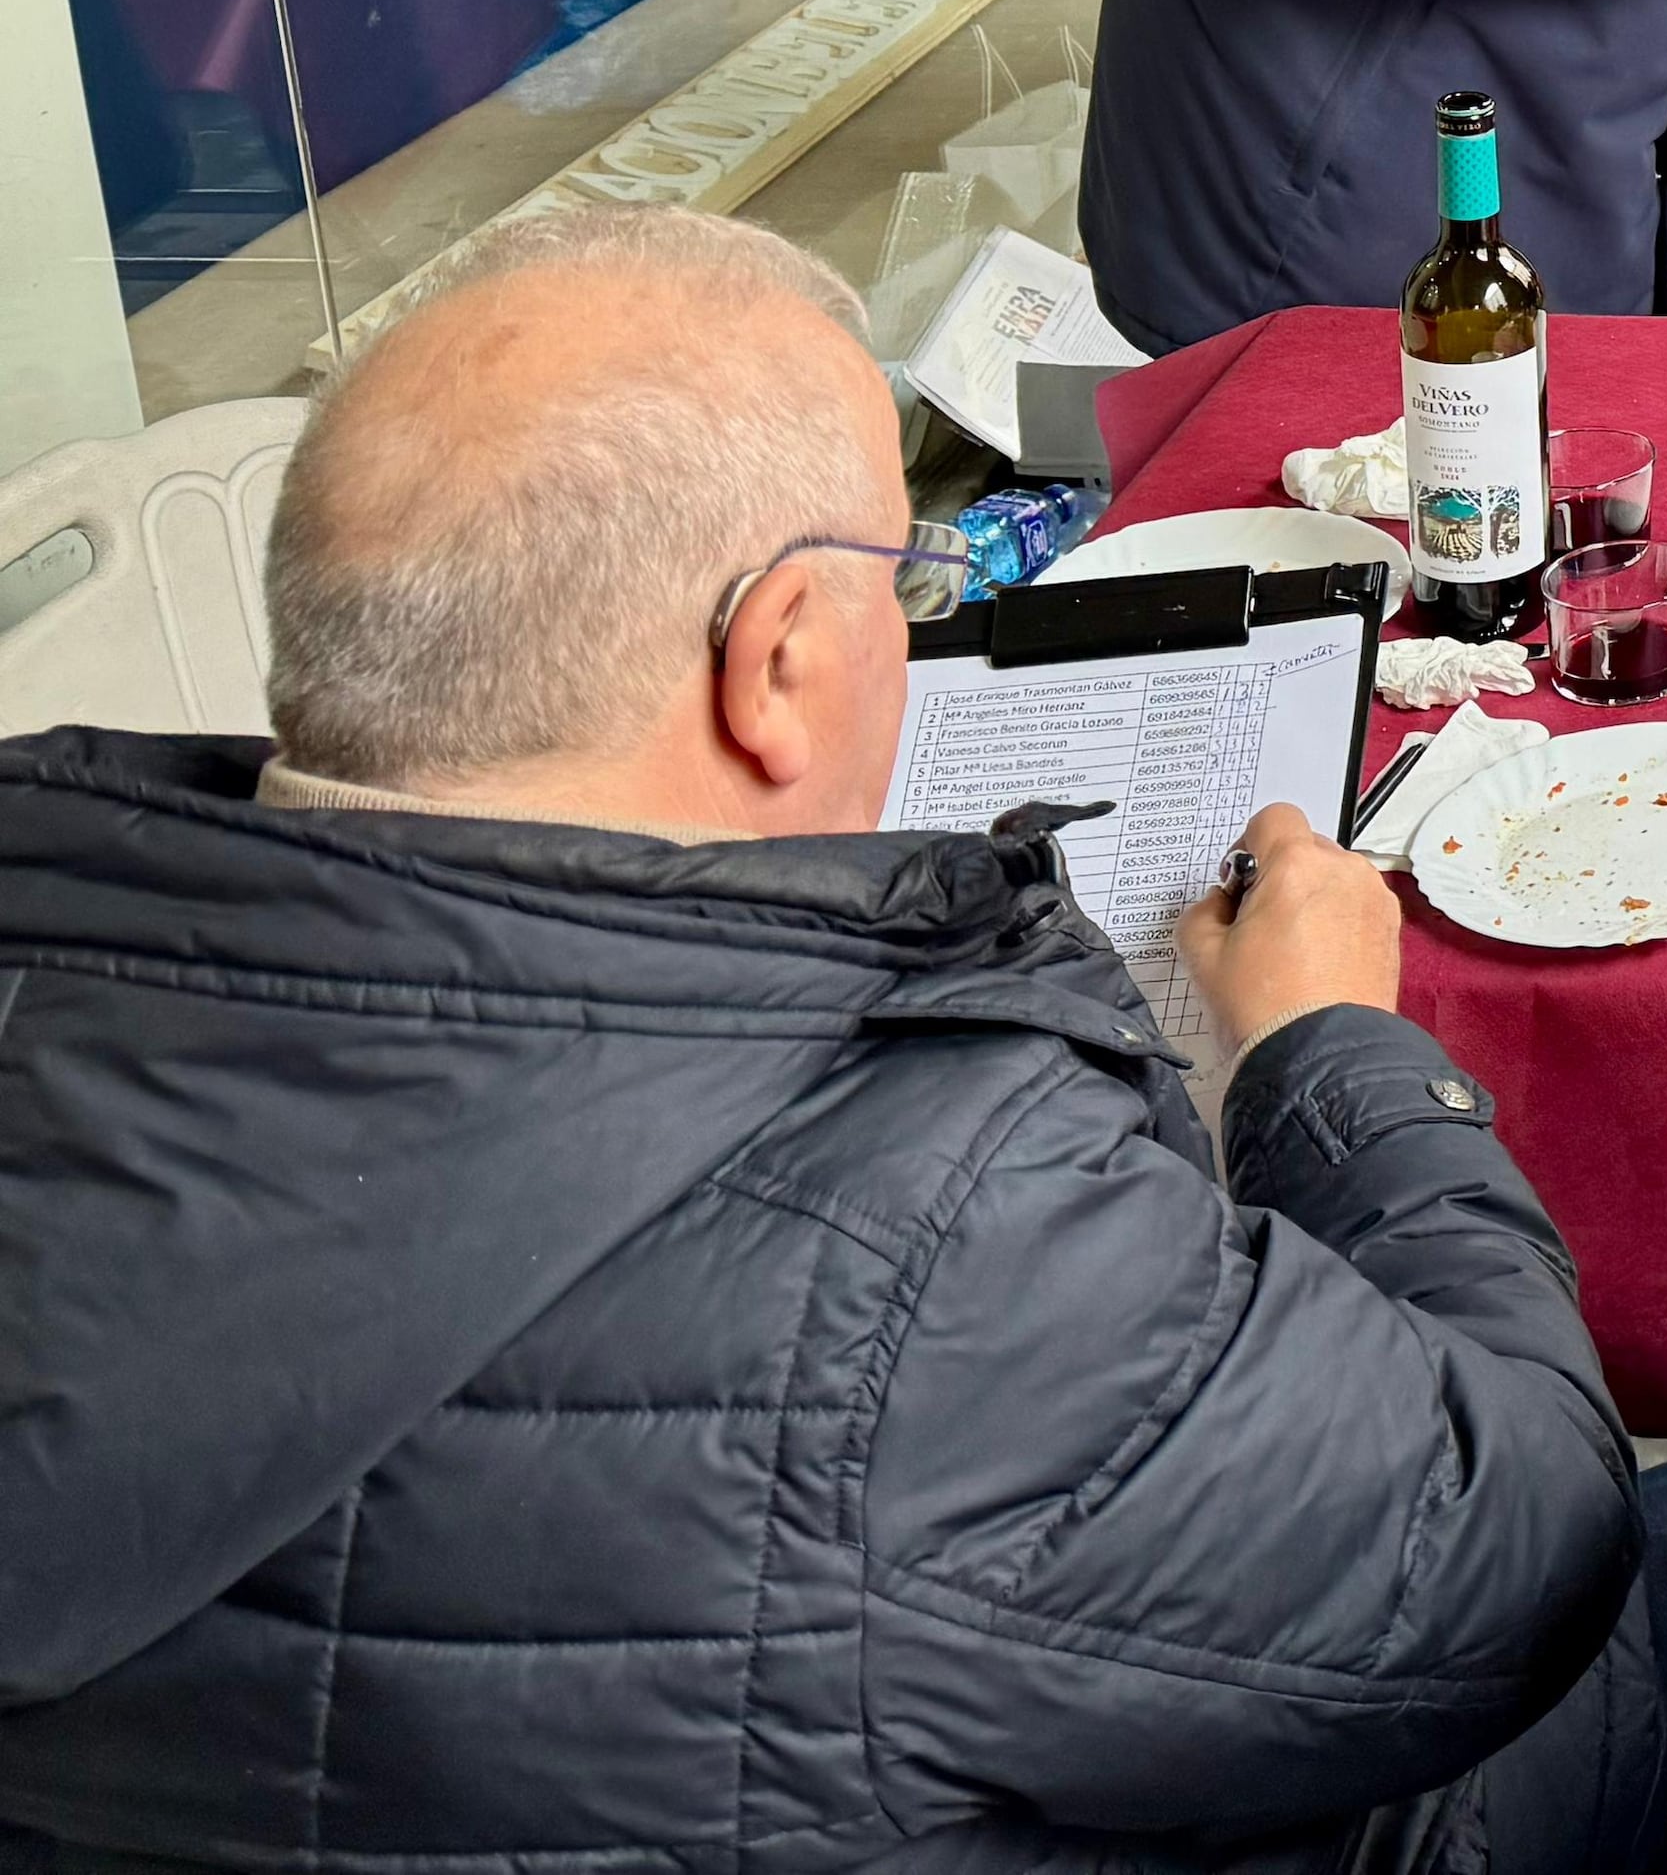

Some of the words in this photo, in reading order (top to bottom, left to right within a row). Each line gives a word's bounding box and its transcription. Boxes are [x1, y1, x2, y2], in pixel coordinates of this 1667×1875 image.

[1418, 382, 1472, 402] VIÑAS
[940, 725, 998, 739] Francisco
[936, 744, 980, 758] Vanesa
[934, 764, 960, 776] Pilar
